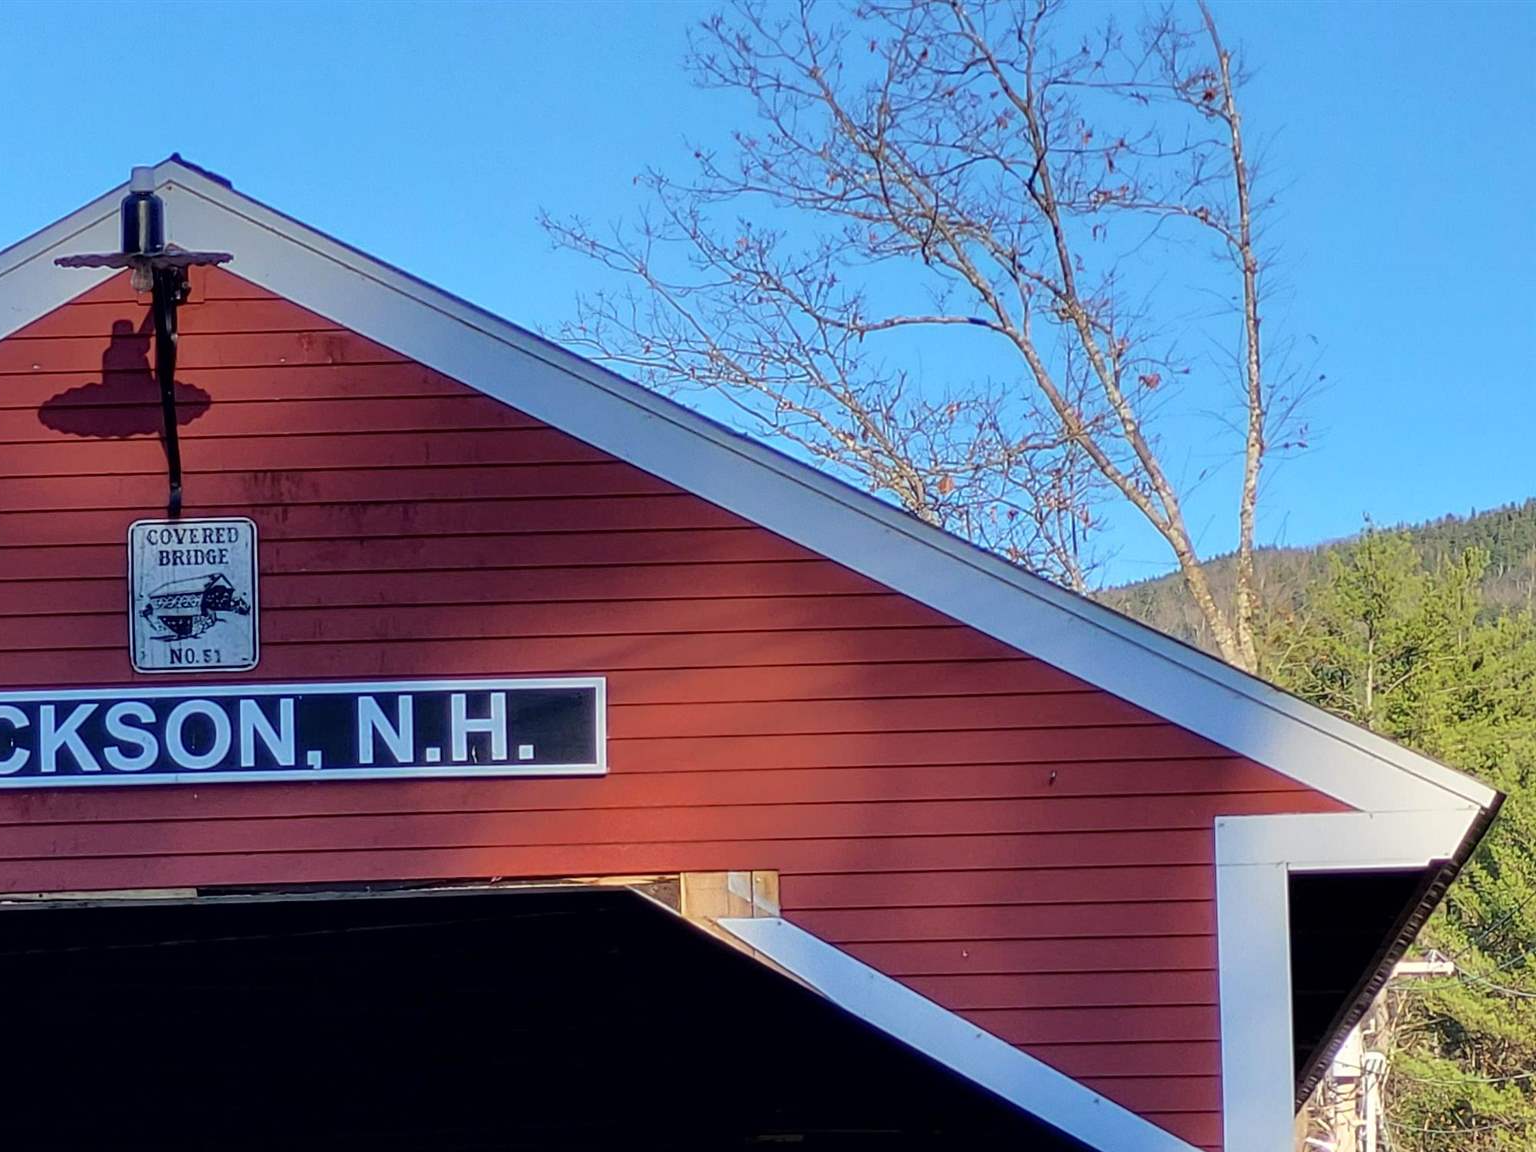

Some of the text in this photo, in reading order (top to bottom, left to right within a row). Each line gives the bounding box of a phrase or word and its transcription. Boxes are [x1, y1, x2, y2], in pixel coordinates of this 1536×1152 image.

[146, 527, 239, 546] COVERED
[158, 548, 229, 566] BRIDGE
[357, 691, 535, 765] N.H.
